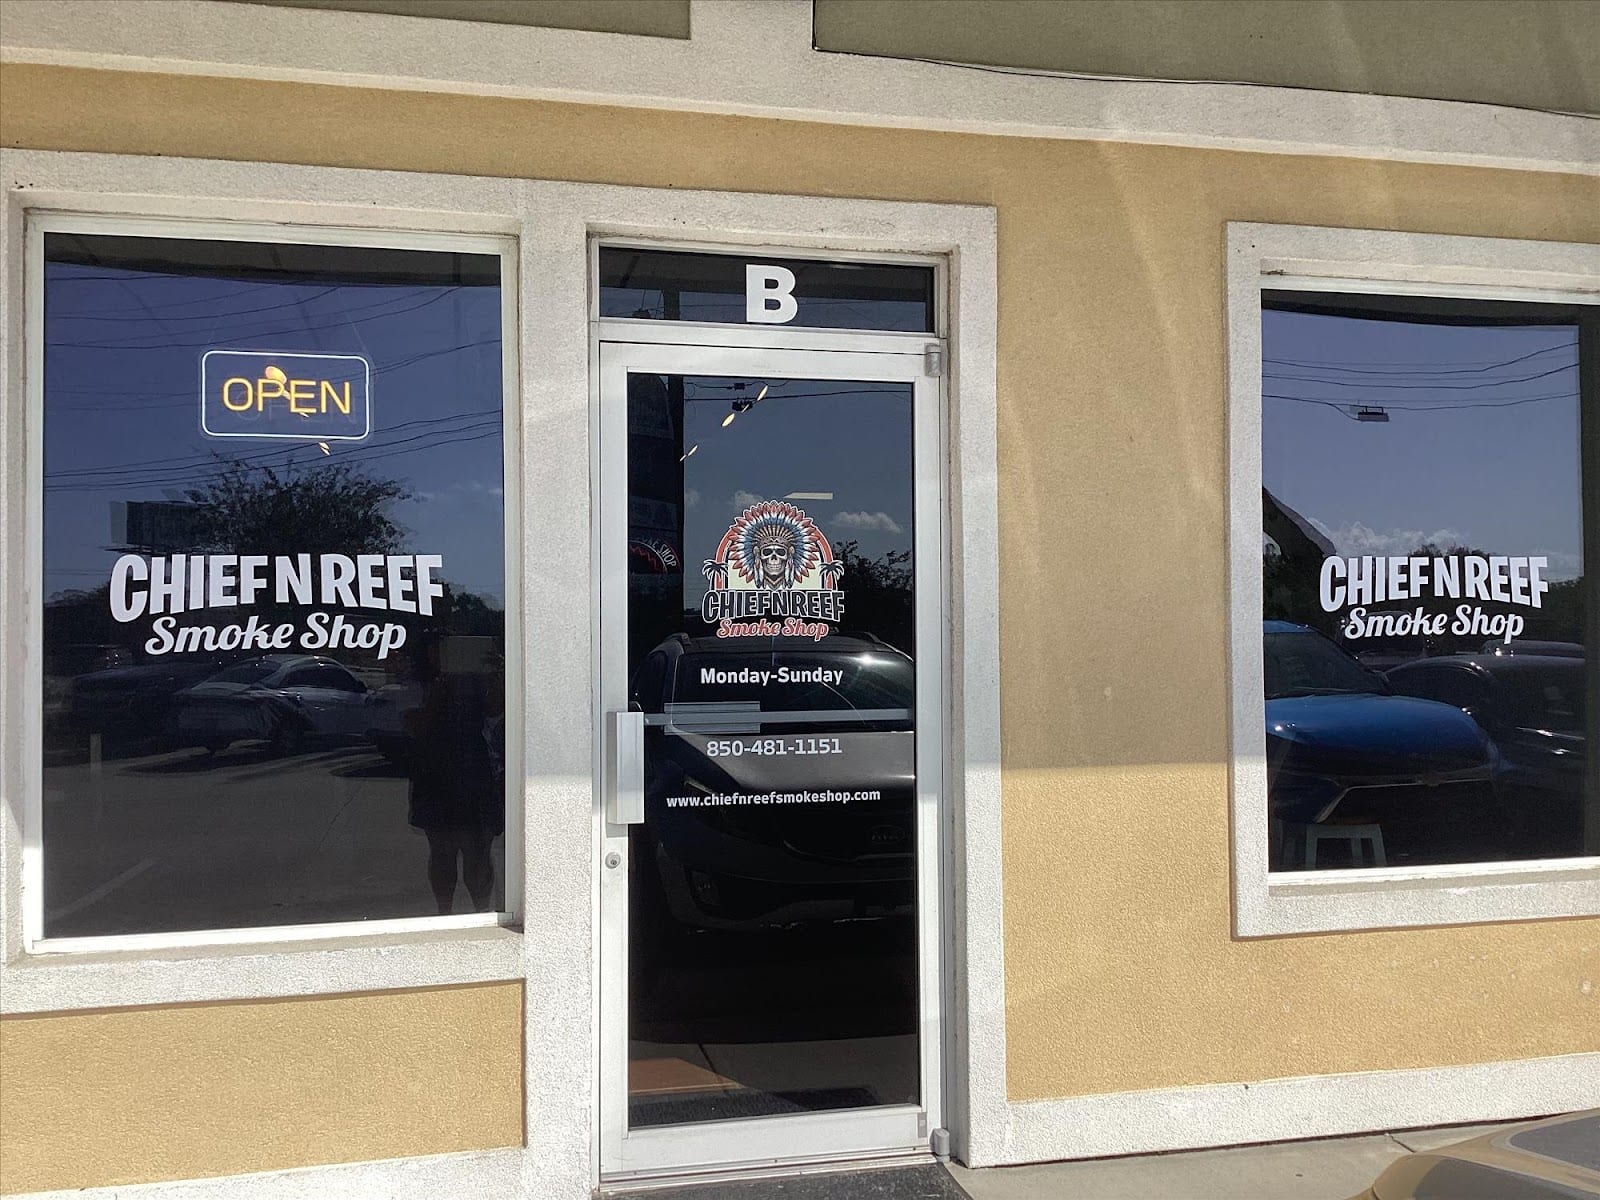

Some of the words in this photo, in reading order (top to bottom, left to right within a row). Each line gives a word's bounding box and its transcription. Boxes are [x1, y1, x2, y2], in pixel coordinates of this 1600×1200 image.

[745, 264, 798, 324] B
[222, 377, 351, 414] OPEN
[656, 543, 677, 567] SHOP
[144, 615, 295, 655] Smoke
[299, 612, 407, 660] Shop
[717, 618, 782, 638] Smoke
[782, 617, 829, 642] Shop
[1344, 607, 1448, 639] Smoke
[1451, 604, 1524, 644] Shop
[700, 667, 844, 687] Monday-Sunday
[706, 738, 843, 757] 850-481-1151
[666, 790, 881, 808] www.chiefnreefsmokeshop.com
